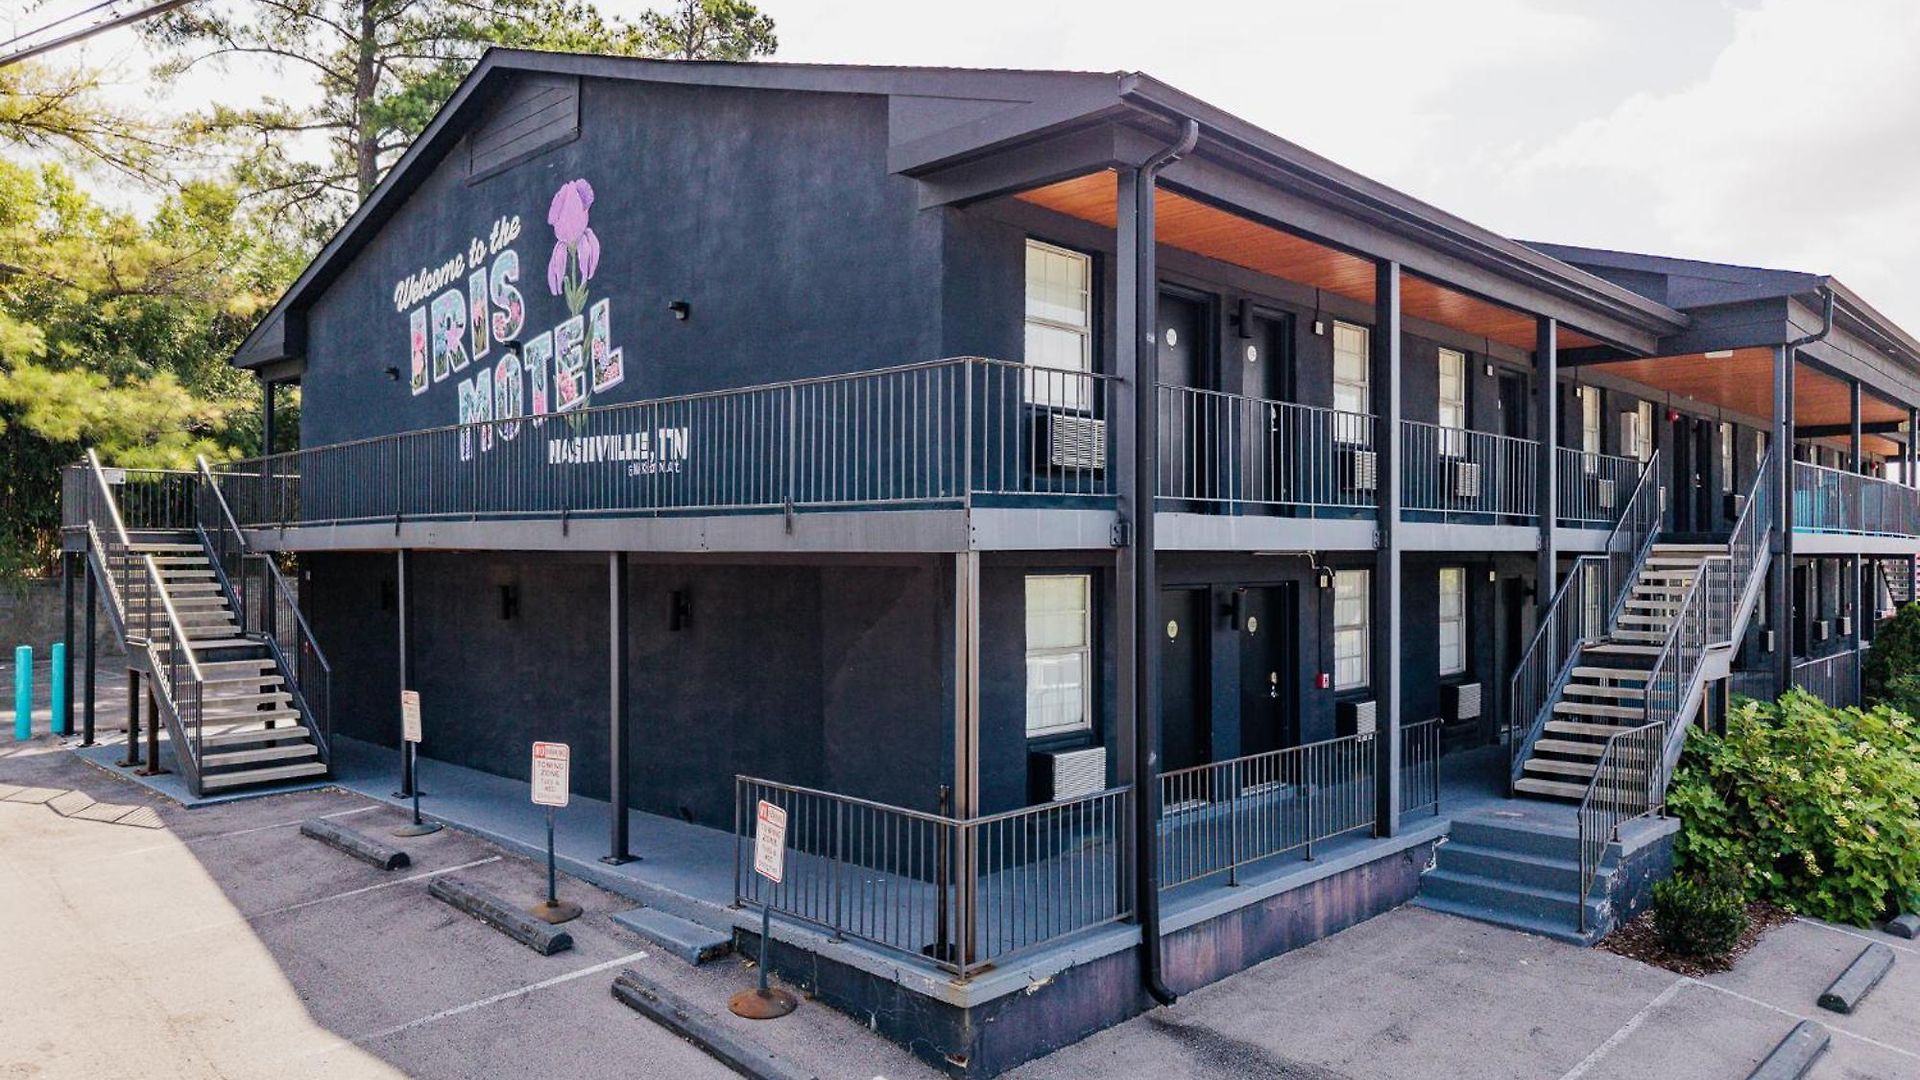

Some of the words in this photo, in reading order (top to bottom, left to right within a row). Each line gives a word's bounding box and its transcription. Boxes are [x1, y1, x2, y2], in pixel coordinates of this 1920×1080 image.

[394, 253, 465, 312] Welcome
[469, 237, 487, 269] to
[490, 215, 521, 254] the
[410, 249, 525, 396] IRIS
[458, 298, 625, 462] MOTEL
[659, 427, 688, 460] TN
